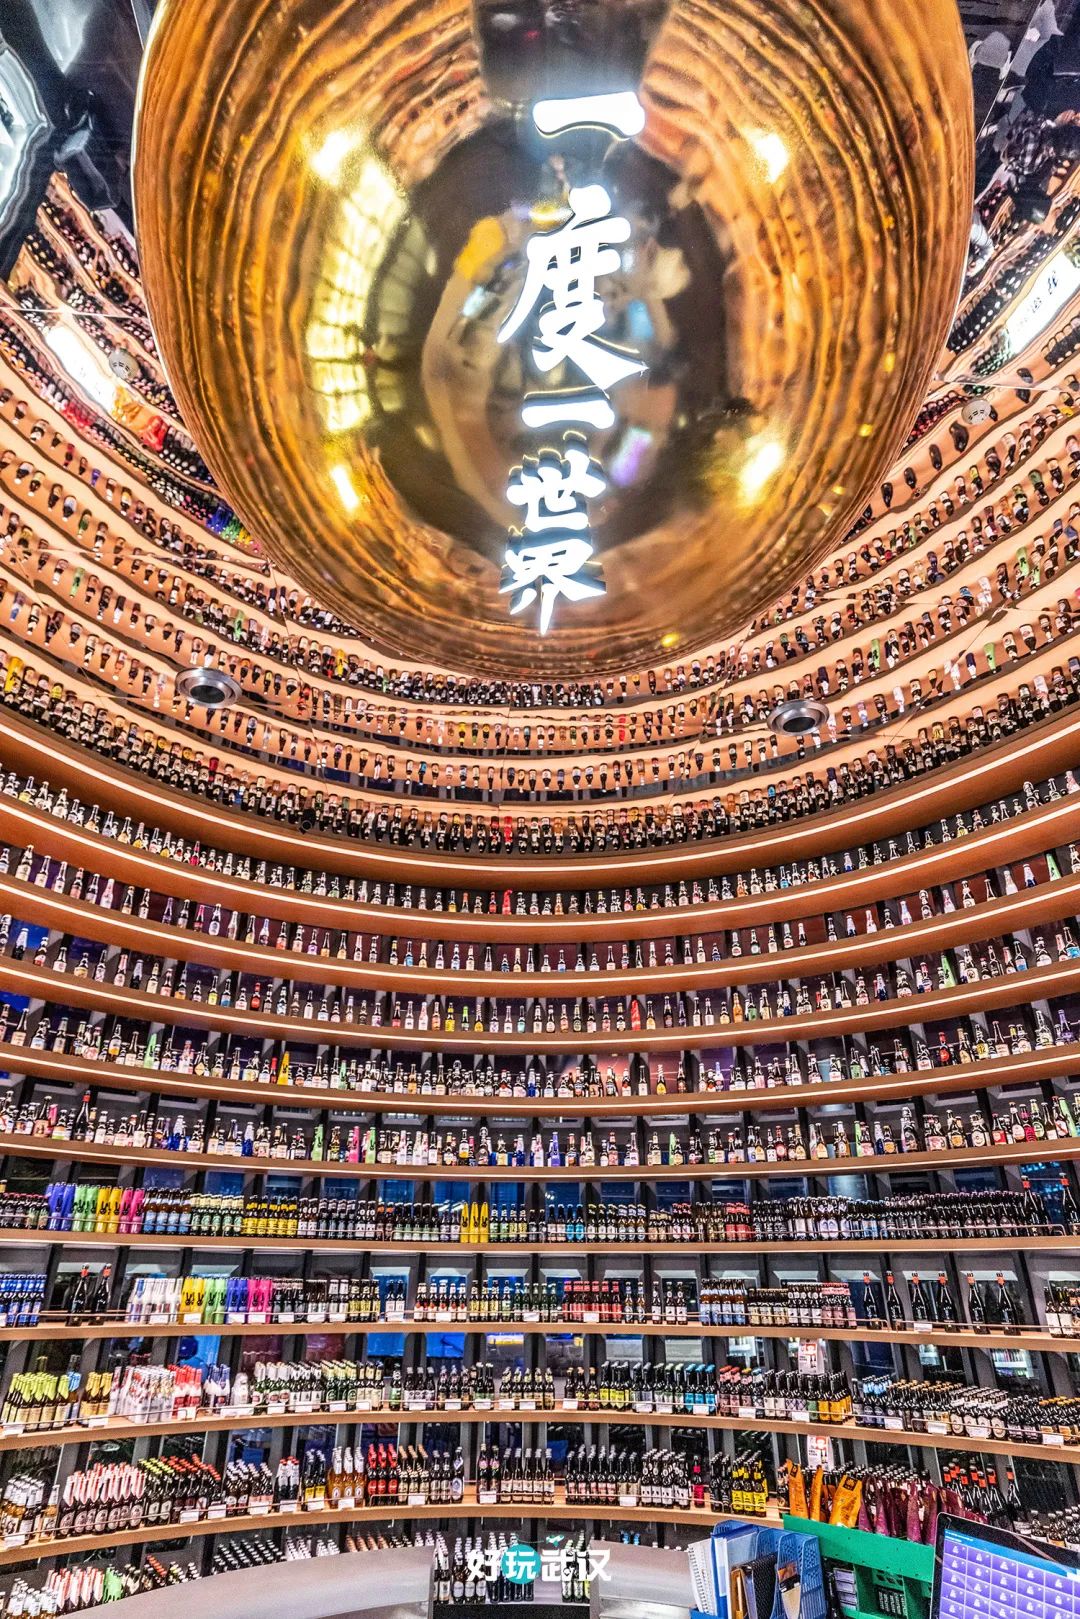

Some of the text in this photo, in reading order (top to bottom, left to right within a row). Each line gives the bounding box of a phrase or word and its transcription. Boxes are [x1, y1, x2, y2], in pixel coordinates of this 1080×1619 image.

[497, 91, 648, 635] 一度一世界
